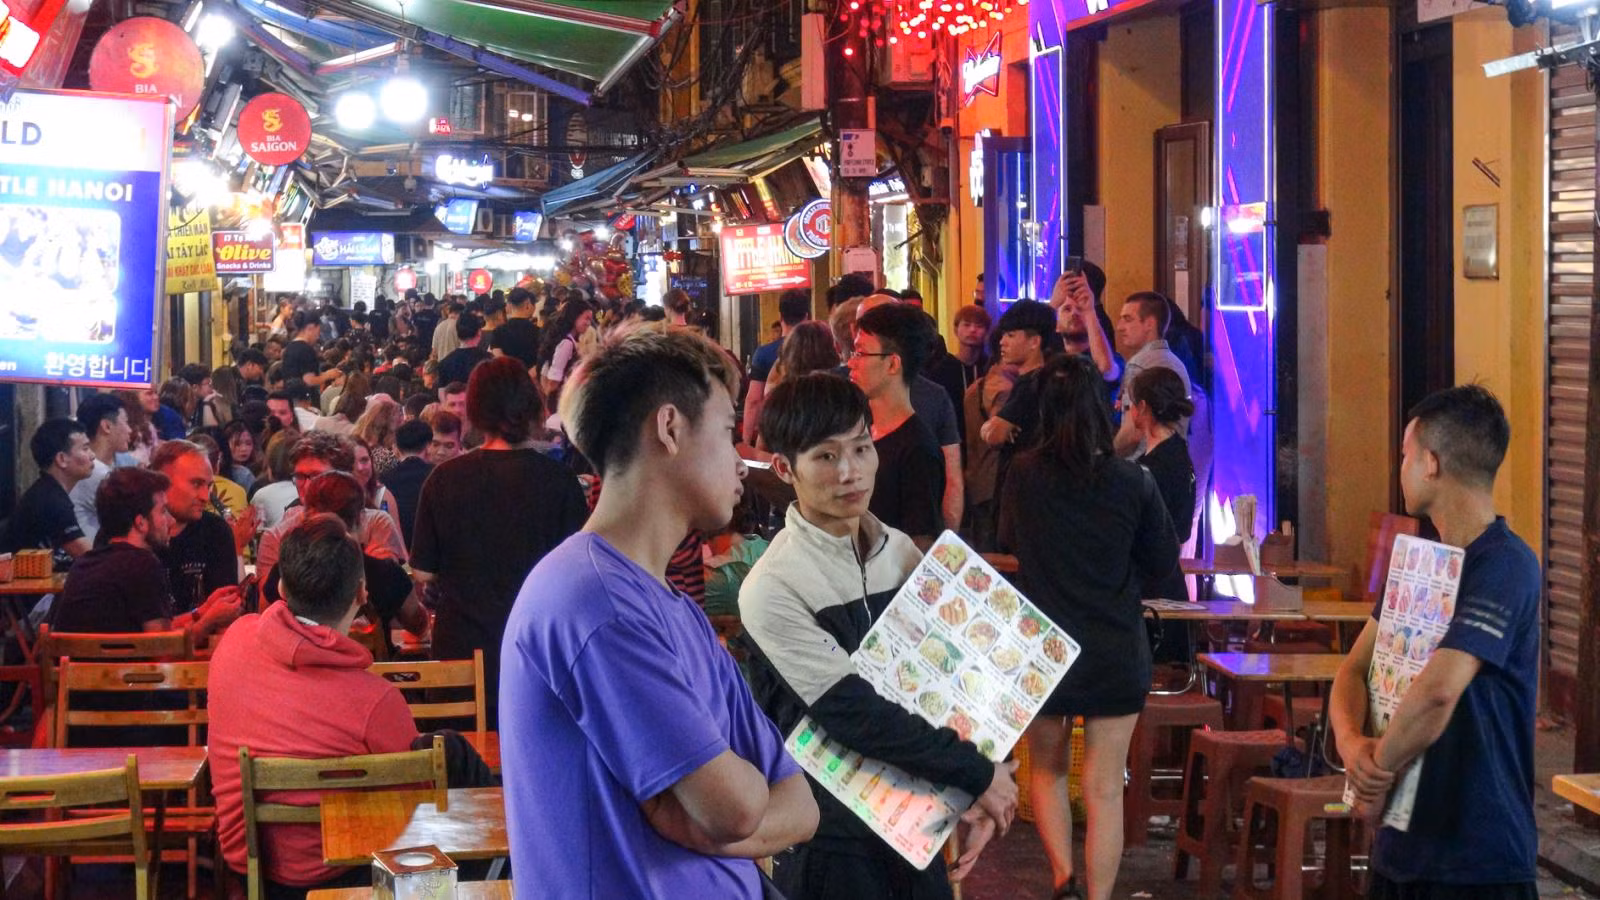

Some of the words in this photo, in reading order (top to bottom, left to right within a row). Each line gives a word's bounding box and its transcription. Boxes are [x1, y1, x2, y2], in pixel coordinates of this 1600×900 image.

[135, 84, 158, 94] BIA
[251, 141, 297, 153] SAIGON
[175, 243, 193, 258] TÂY
[216, 244, 272, 262] Olive
[216, 262, 241, 270] Snacks
[242, 262, 248, 270] &
[249, 262, 271, 270] Drinks
[44, 351, 152, 382] 환영합니다
